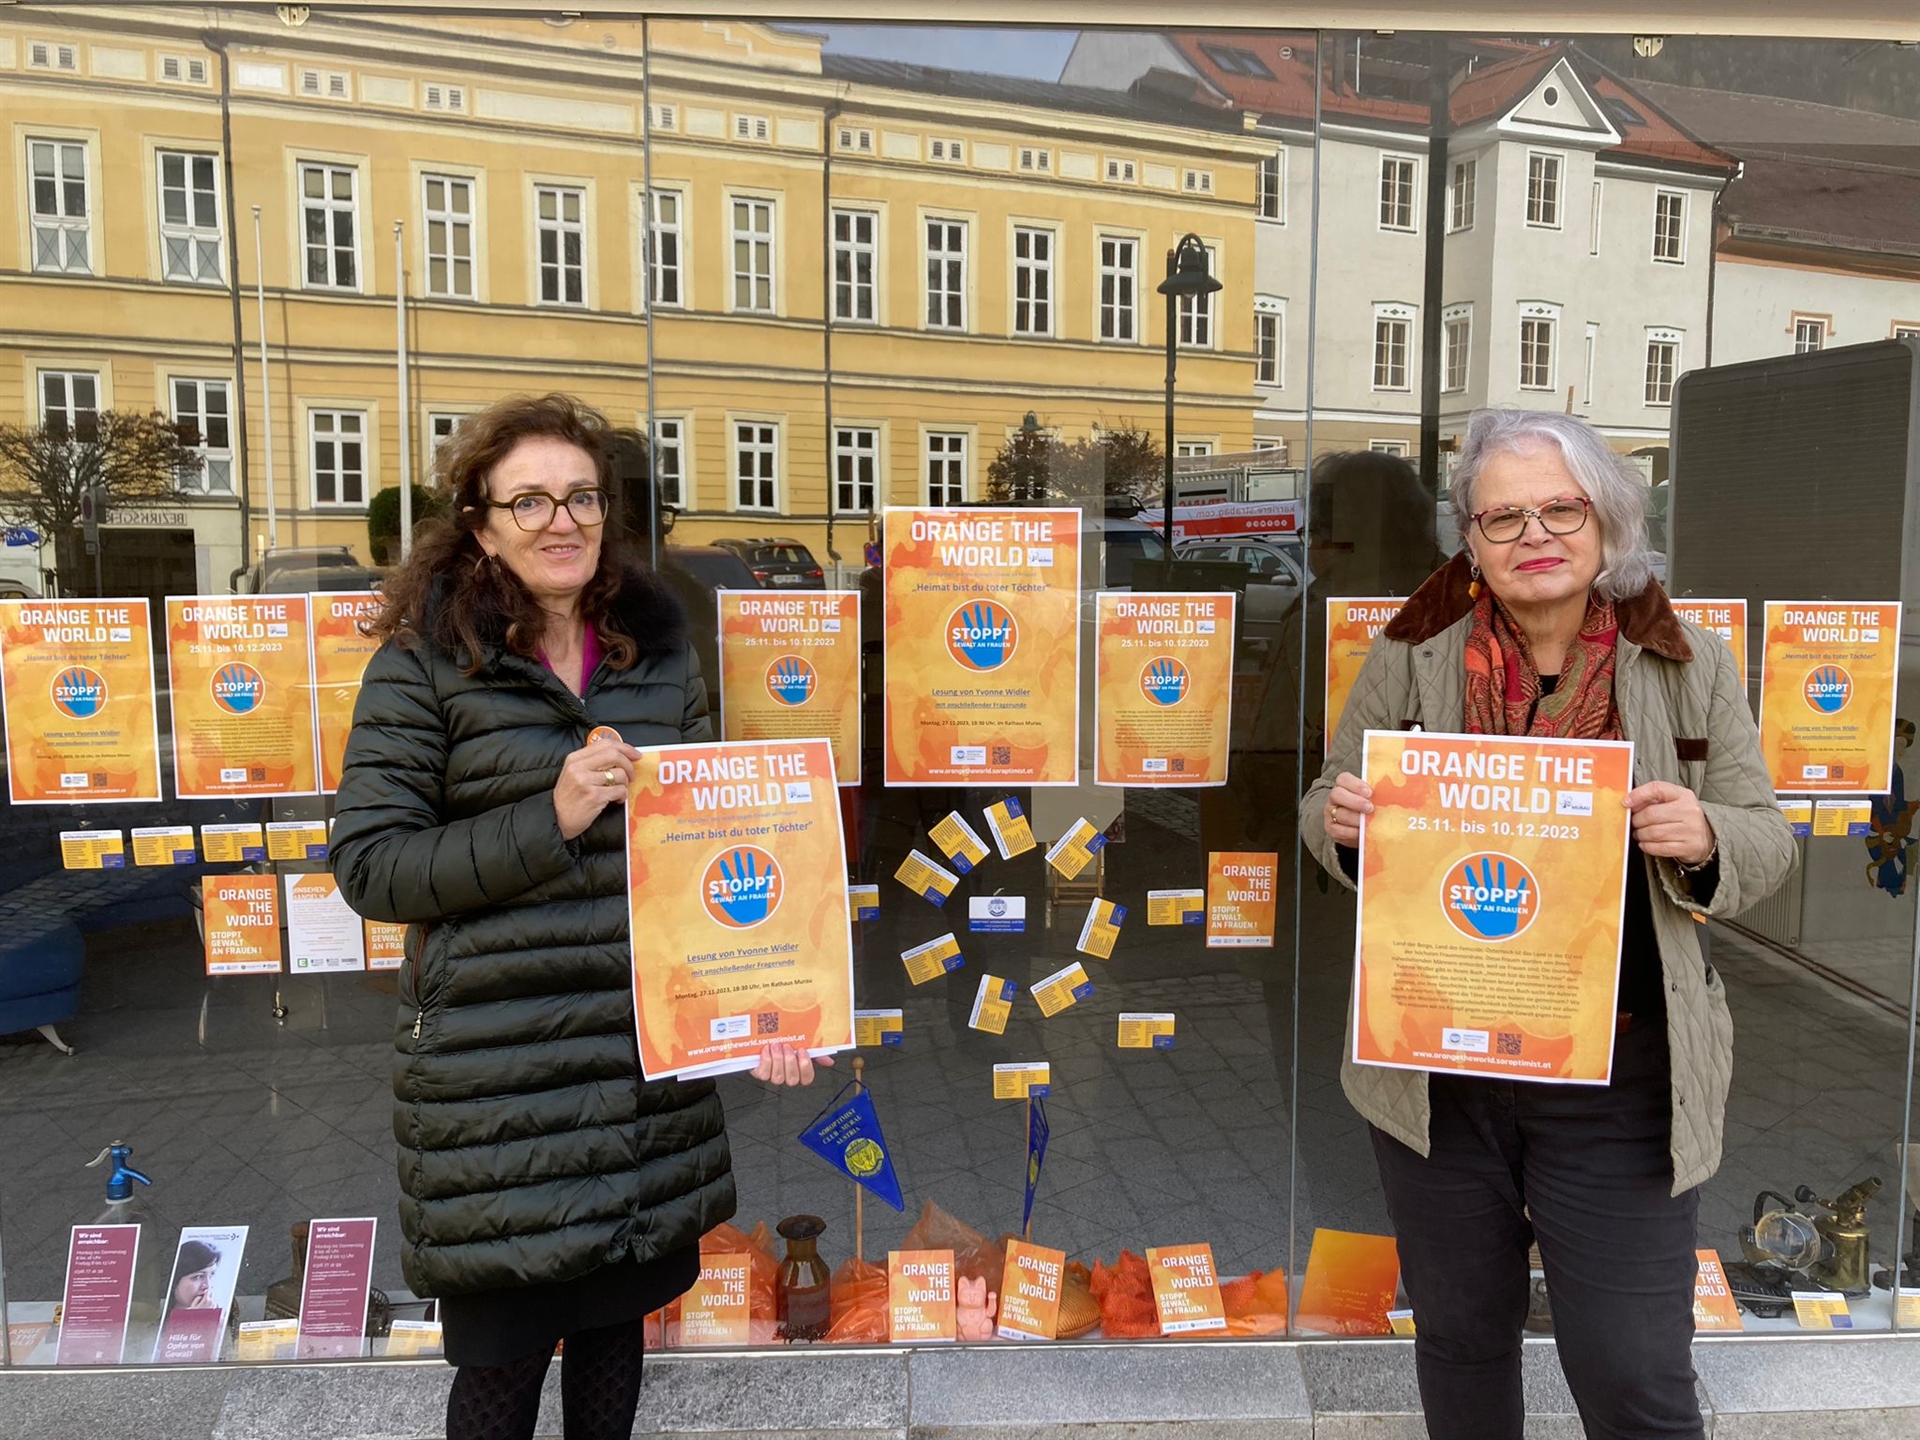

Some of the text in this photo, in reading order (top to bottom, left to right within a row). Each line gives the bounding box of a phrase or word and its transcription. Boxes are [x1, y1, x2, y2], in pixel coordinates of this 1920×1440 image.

[911, 521, 1052, 542] ORANGE THE
[941, 546, 1023, 567] WORLD
[182, 605, 286, 622] ORANGE THE
[332, 602, 383, 617] ORAN
[740, 601, 840, 615] ORANGE THE
[1117, 603, 1214, 617] ORANGE THE
[20, 609, 130, 625] ORANGE THE
[1347, 608, 1400, 622] ORANG
[1673, 610, 1731, 623] NGE THE
[1784, 611, 1879, 626] ORANGE THE
[204, 623, 264, 639] WORLD
[761, 618, 819, 632] WORLD
[1137, 620, 1193, 634] WORLD
[42, 628, 106, 643] WORLD
[952, 628, 1012, 640] STOPPT
[1802, 628, 1859, 642] WORLD
[190, 643, 283, 654] 25.11. bis 10.12.2023
[774, 638, 786, 646] bis
[790, 638, 835, 646] 10.12.2023
[770, 675, 812, 684] STOPPT
[1144, 676, 1185, 684] STOPPT
[56, 686, 102, 696] STOPPT
[215, 682, 259, 692] STOPPT
[932, 688, 958, 696] Lesung
[976, 688, 1003, 696] Yvonne
[1005, 688, 1030, 696] Widler
[1808, 684, 1848, 693] STOPPT
[658, 754, 807, 785] ORANGE THE
[1401, 749, 1594, 784] ORANGE THE
[692, 782, 782, 811] WORLD
[1439, 782, 1550, 814] WORLD
[661, 832, 705, 844] „Heimat
[708, 829, 727, 839] bist
[730, 827, 742, 837] du
[745, 825, 770, 836] toter
[1408, 816, 1580, 840] 25.11. bis 10.12.2023
[1223, 866, 1271, 877] ORANGE
[709, 875, 776, 896] STOPPT
[1248, 878, 1270, 889] THE
[219, 889, 272, 901] ORANGE
[710, 895, 737, 904] GEWALT
[749, 891, 776, 900] FRAUEN
[1227, 891, 1270, 902] WORLD
[1450, 885, 1531, 904] STOPPT
[248, 902, 272, 913] THE
[1451, 902, 1482, 912] GEWALT
[1496, 905, 1528, 915] FRAUEN
[226, 915, 273, 926] WORLD
[211, 931, 242, 939] STOPPT
[687, 943, 798, 963] Lesung von Yvonne Widler
[691, 968, 703, 976] mit
[757, 958, 795, 970] Fragerunde
[675, 992, 697, 1000] Montag,
[700, 987, 731, 996] 27.11.2023,
[794, 978, 812, 986] Murau
[687, 1034, 805, 1057] www.orangetheworld.soroptimist.at
[1412, 1050, 1551, 1070] www.orangetheworld.soroptimist.at
[822, 1130, 839, 1145] CLUB
[836, 1126, 860, 1145] AUSTRIA
[1018, 1255, 1059, 1276] ORANGE
[1162, 1255, 1208, 1267] ORANGE
[699, 1268, 745, 1279] ORANGE
[903, 1263, 949, 1276] ORANGE
[1189, 1265, 1211, 1276] THE
[928, 1277, 949, 1288] THE
[1038, 1274, 1058, 1288] THE
[1171, 1276, 1213, 1288] WORLD
[1698, 1273, 1722, 1284] THE
[723, 1282, 745, 1292] THE
[1019, 1283, 1056, 1302] WORLD
[1695, 1286, 1726, 1296] ORLD
[702, 1295, 744, 1306] WORLD
[908, 1290, 950, 1302] WORLD
[1005, 1295, 1029, 1307] STOPPT
[1160, 1292, 1187, 1300] STOPPT
[1004, 1303, 1030, 1315] GEWALT
[1161, 1300, 1190, 1308] GEWALT
[686, 1312, 714, 1320] STOPPT
[894, 1307, 922, 1315] STOPPT
[894, 1315, 924, 1323] GEWALT
[1003, 1311, 1039, 1326] AN FRAUEN
[894, 1323, 905, 1331] AN
[167, 1342, 190, 1350] Opfer
